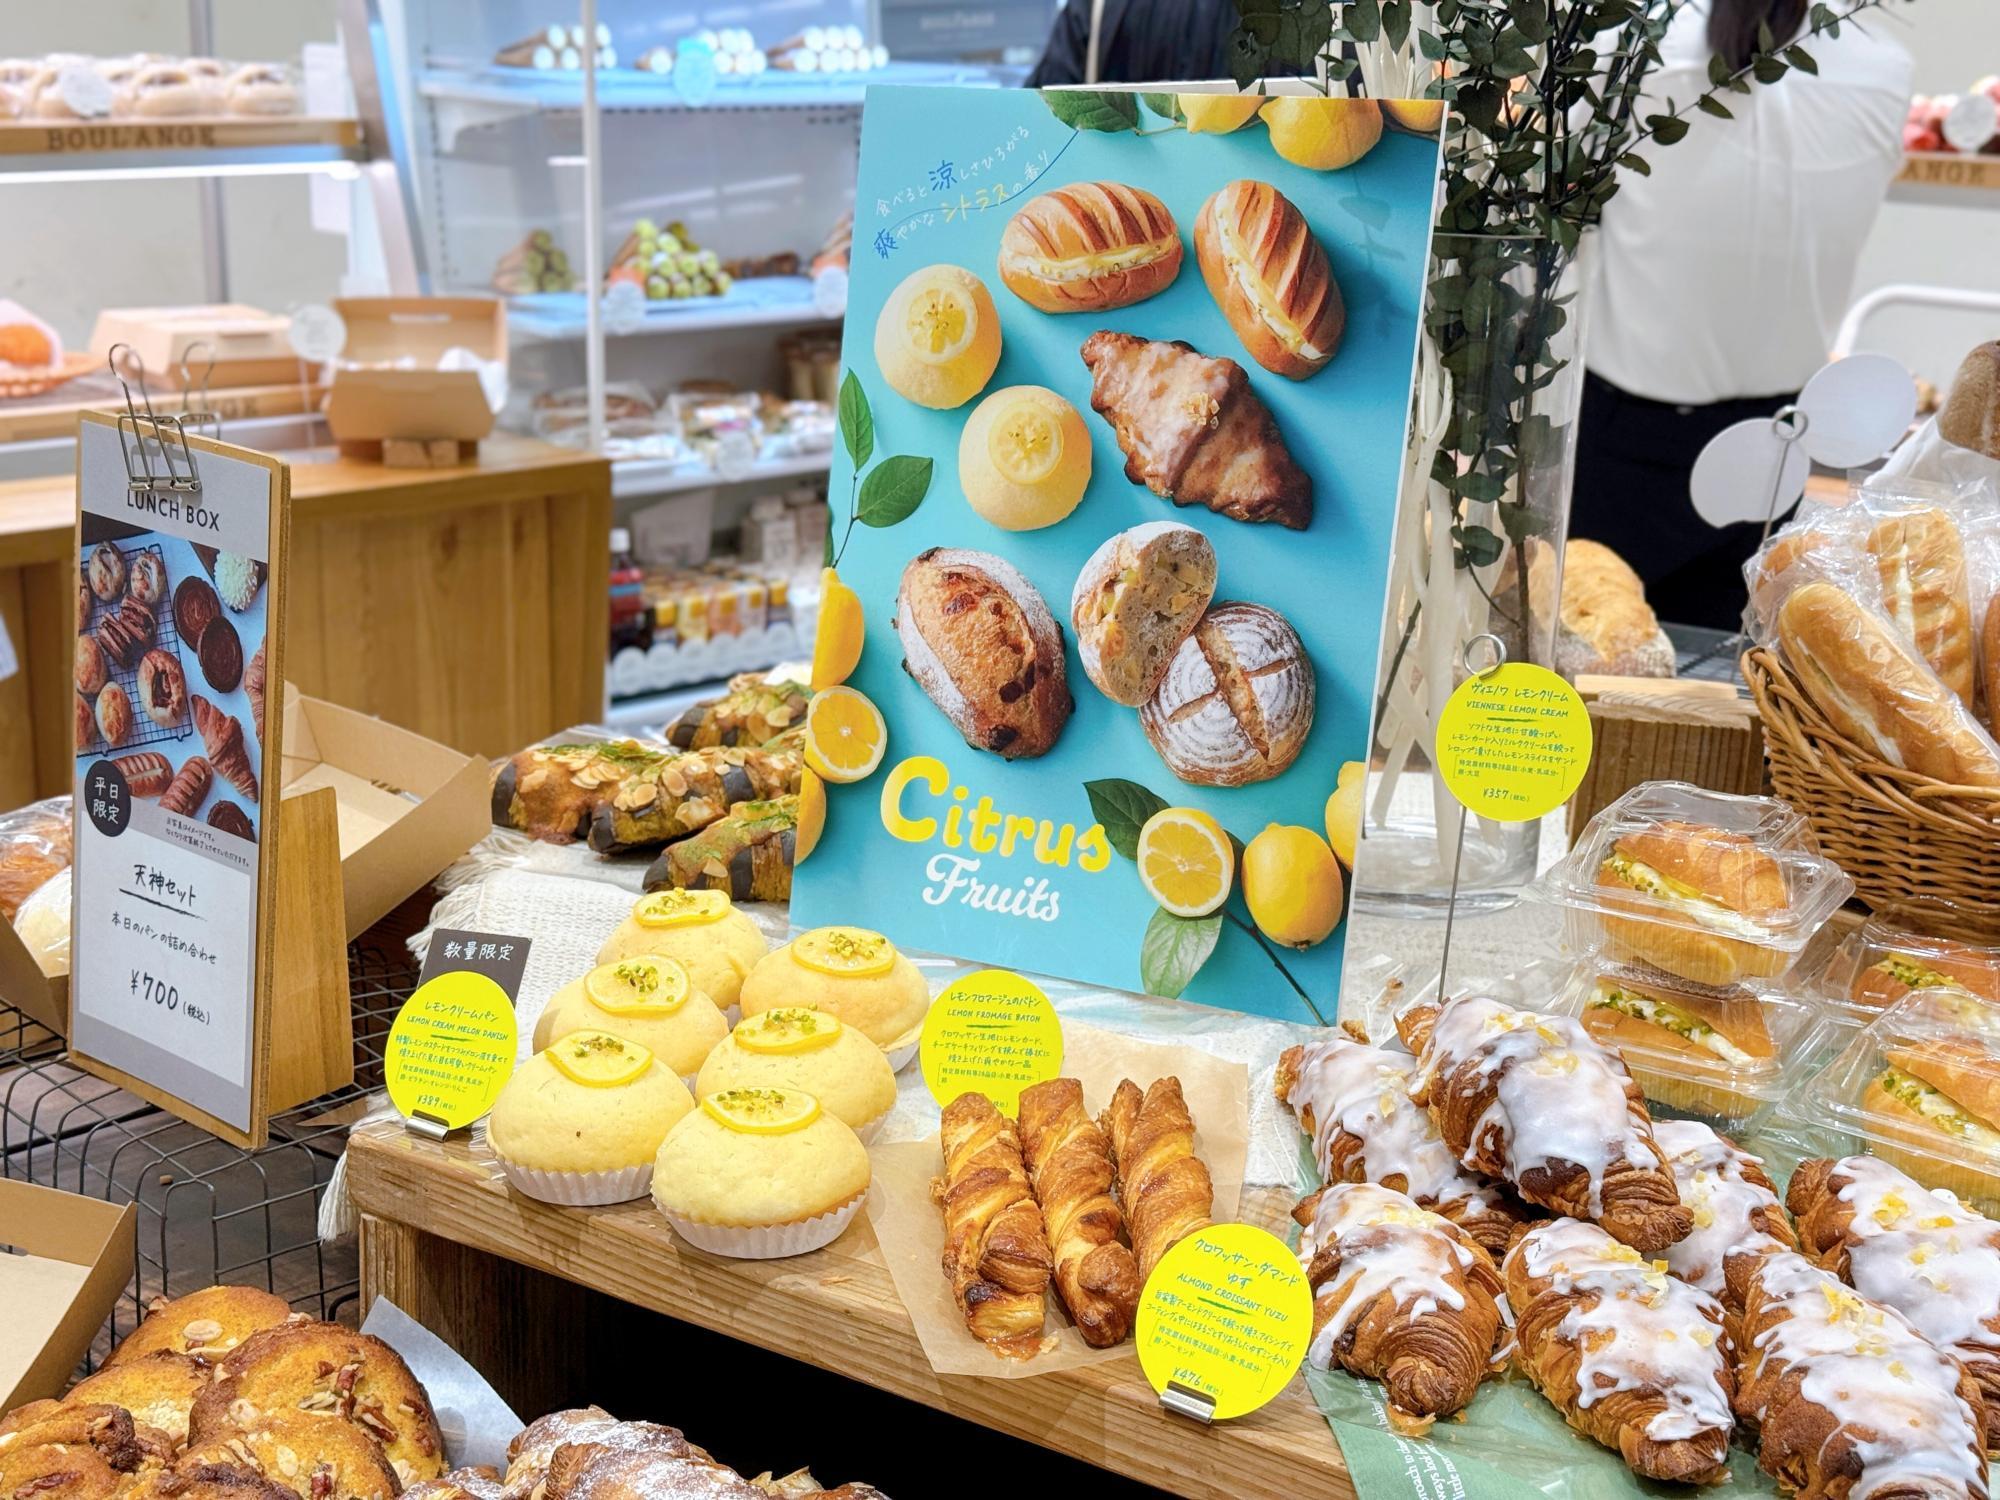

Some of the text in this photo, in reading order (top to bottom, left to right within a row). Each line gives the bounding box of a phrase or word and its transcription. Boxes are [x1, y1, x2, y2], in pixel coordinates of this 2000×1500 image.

[875, 125, 1030, 217] 食べると涼しさひろがる
[873, 149, 1051, 260] 爽やかなシトラスの香り
[126, 488, 221, 532] LUNCH BOX
[1514, 688, 1569, 702] レモンクリーム
[1466, 700, 1569, 718] VIENNESE LEMON CREAM
[94, 776, 119, 801] 平日
[1482, 787, 1510, 800] ¥357
[93, 802, 120, 825] 限定
[880, 755, 1112, 873] Citrus
[133, 863, 197, 907] 天神セット
[921, 852, 1061, 922] Fruits
[111, 911, 218, 965] 本日のパンの詰め合わせ
[443, 940, 515, 962] 数量限定
[130, 968, 211, 1026] ¥700 (税込)
[950, 991, 1041, 1009] レモンフロマージュのバトン
[424, 1000, 501, 1023] レモンクリームパン
[947, 1008, 1041, 1023] LEMON FROMAGE BATON
[406, 1015, 509, 1042] LEMON CREAM MELON DANISH
[1194, 1238, 1302, 1288] クロワッサン・ダマンド
[1227, 1273, 1253, 1290] ゆず
[1177, 1272, 1289, 1322] ALMOND CROISSANT YUZU
[1172, 1366, 1202, 1386] ¥476
